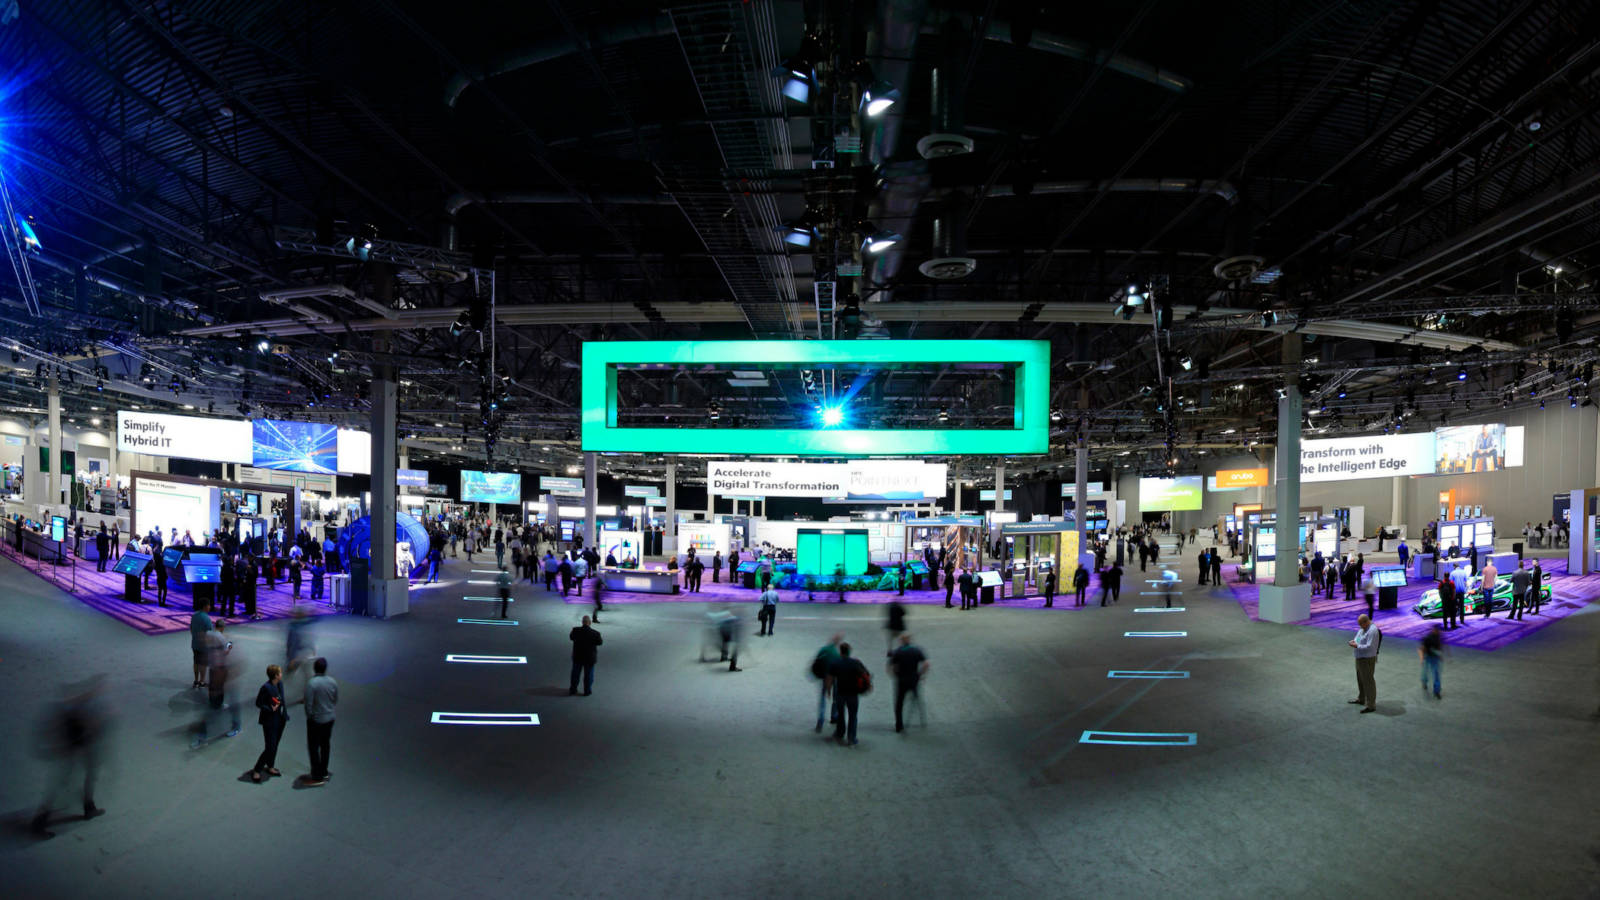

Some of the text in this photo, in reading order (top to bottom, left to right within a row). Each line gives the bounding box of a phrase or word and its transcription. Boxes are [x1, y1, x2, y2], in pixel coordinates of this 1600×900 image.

[123, 419, 165, 434] Simplify
[124, 434, 172, 447] Hybrid IT
[1359, 444, 1384, 455] with
[1300, 458, 1407, 474] he Intelligent Edge
[714, 468, 772, 478] Accelerate
[1231, 473, 1254, 481] aruba
[714, 480, 840, 491] Digital Transformation
